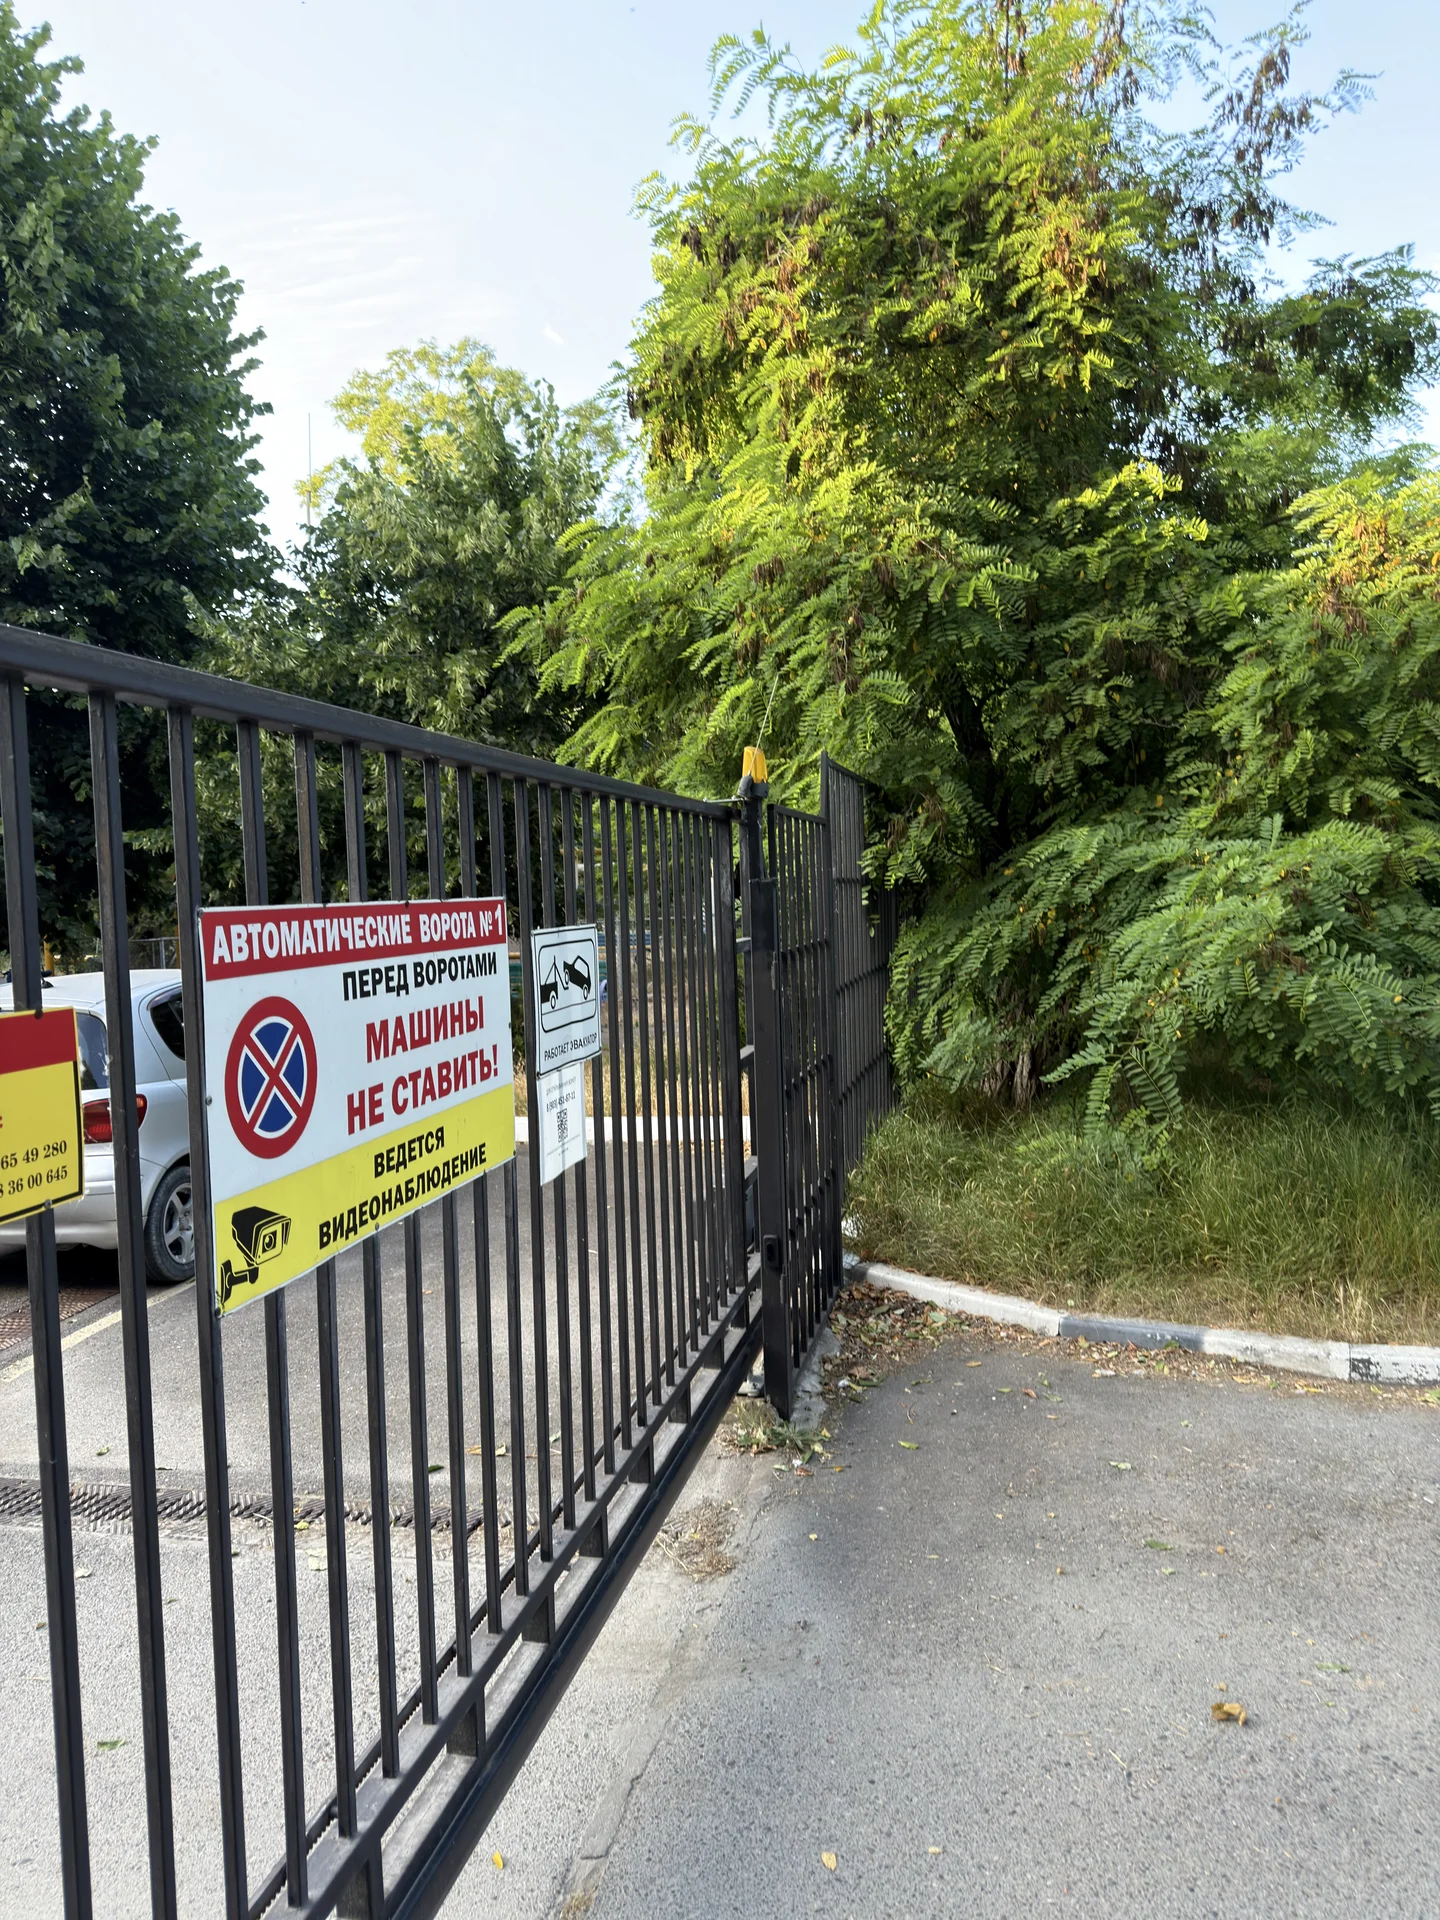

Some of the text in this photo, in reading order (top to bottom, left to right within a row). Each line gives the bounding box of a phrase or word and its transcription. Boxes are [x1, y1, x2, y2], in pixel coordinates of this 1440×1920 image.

[212, 913, 412, 964] АВТОМАТИЧЕСКИЕ
[420, 912, 475, 943] ВОРОТА
[342, 951, 498, 1001] ПЕРЕД ВОРОТАМИ
[366, 996, 484, 1063] МАШИНЫ
[544, 1032, 597, 1062] РАБОТАЕТ ЭВАКУАТОР
[347, 1044, 498, 1136] НЕ СТАВИТЬ!
[22, 1147, 39, 1164] 49
[43, 1140, 67, 1159] 280
[374, 1126, 445, 1178] ВЕДЕТСЯ
[8, 1177, 24, 1195] 36
[27, 1172, 43, 1189] 00
[46, 1165, 68, 1183] 645
[319, 1142, 487, 1250] ВИДЕОНАБЛЮДЕНИЕ
